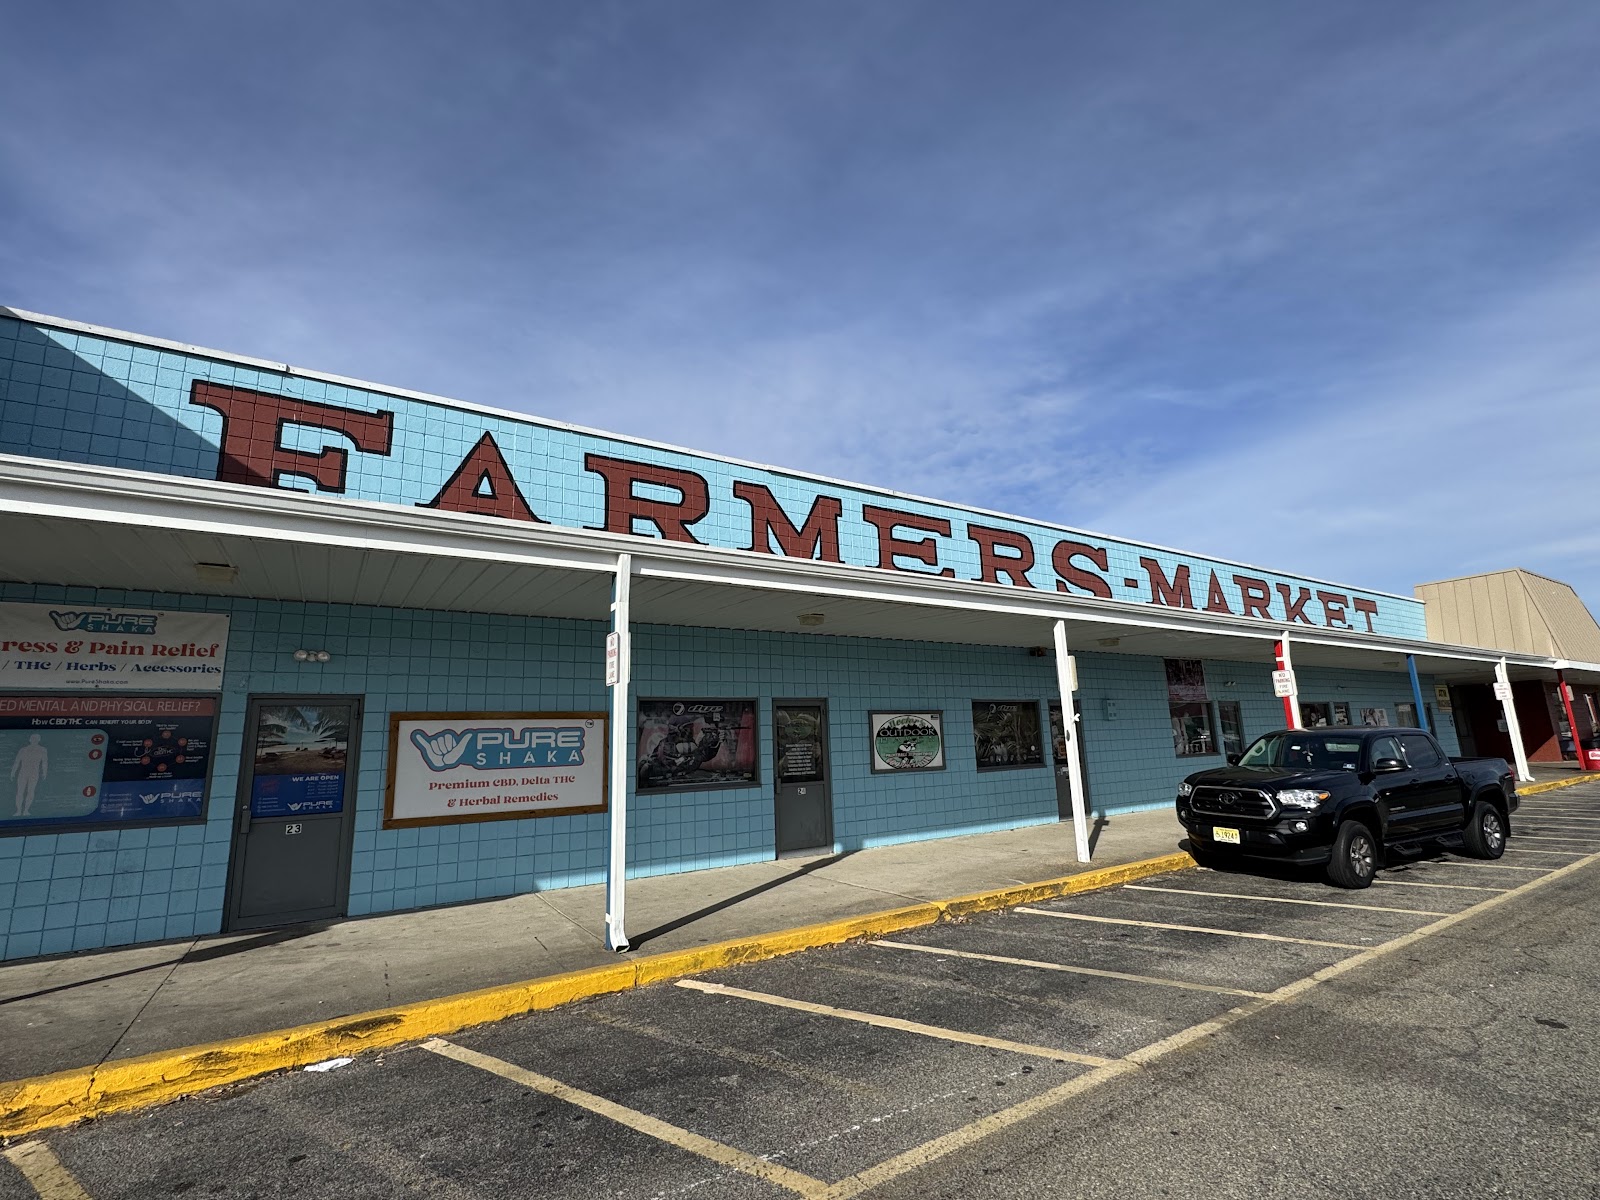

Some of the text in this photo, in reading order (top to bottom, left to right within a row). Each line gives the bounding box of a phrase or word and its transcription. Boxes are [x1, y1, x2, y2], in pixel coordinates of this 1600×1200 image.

[88, 613, 157, 625] PURE
[87, 623, 153, 632] SHAKA
[65, 640, 83, 654] &
[89, 641, 144, 656] Pain
[151, 643, 219, 657] Relief
[14, 661, 51, 670] THC
[66, 662, 116, 672] Herbs
[131, 664, 221, 673] Accessories
[18, 700, 68, 712] MENTAL
[70, 700, 99, 712] AND
[99, 700, 154, 712] PHYSICAL
[156, 701, 201, 712] RELIEF?
[880, 728, 935, 737] OUTDOOR
[477, 730, 581, 750] PURE
[476, 750, 580, 765] SHAKA
[429, 779, 490, 790] Premium
[521, 777, 550, 786] Delta
[553, 775, 575, 784] THC
[447, 792, 558, 808] & Herbal Remedies
[287, 824, 301, 834] 23
